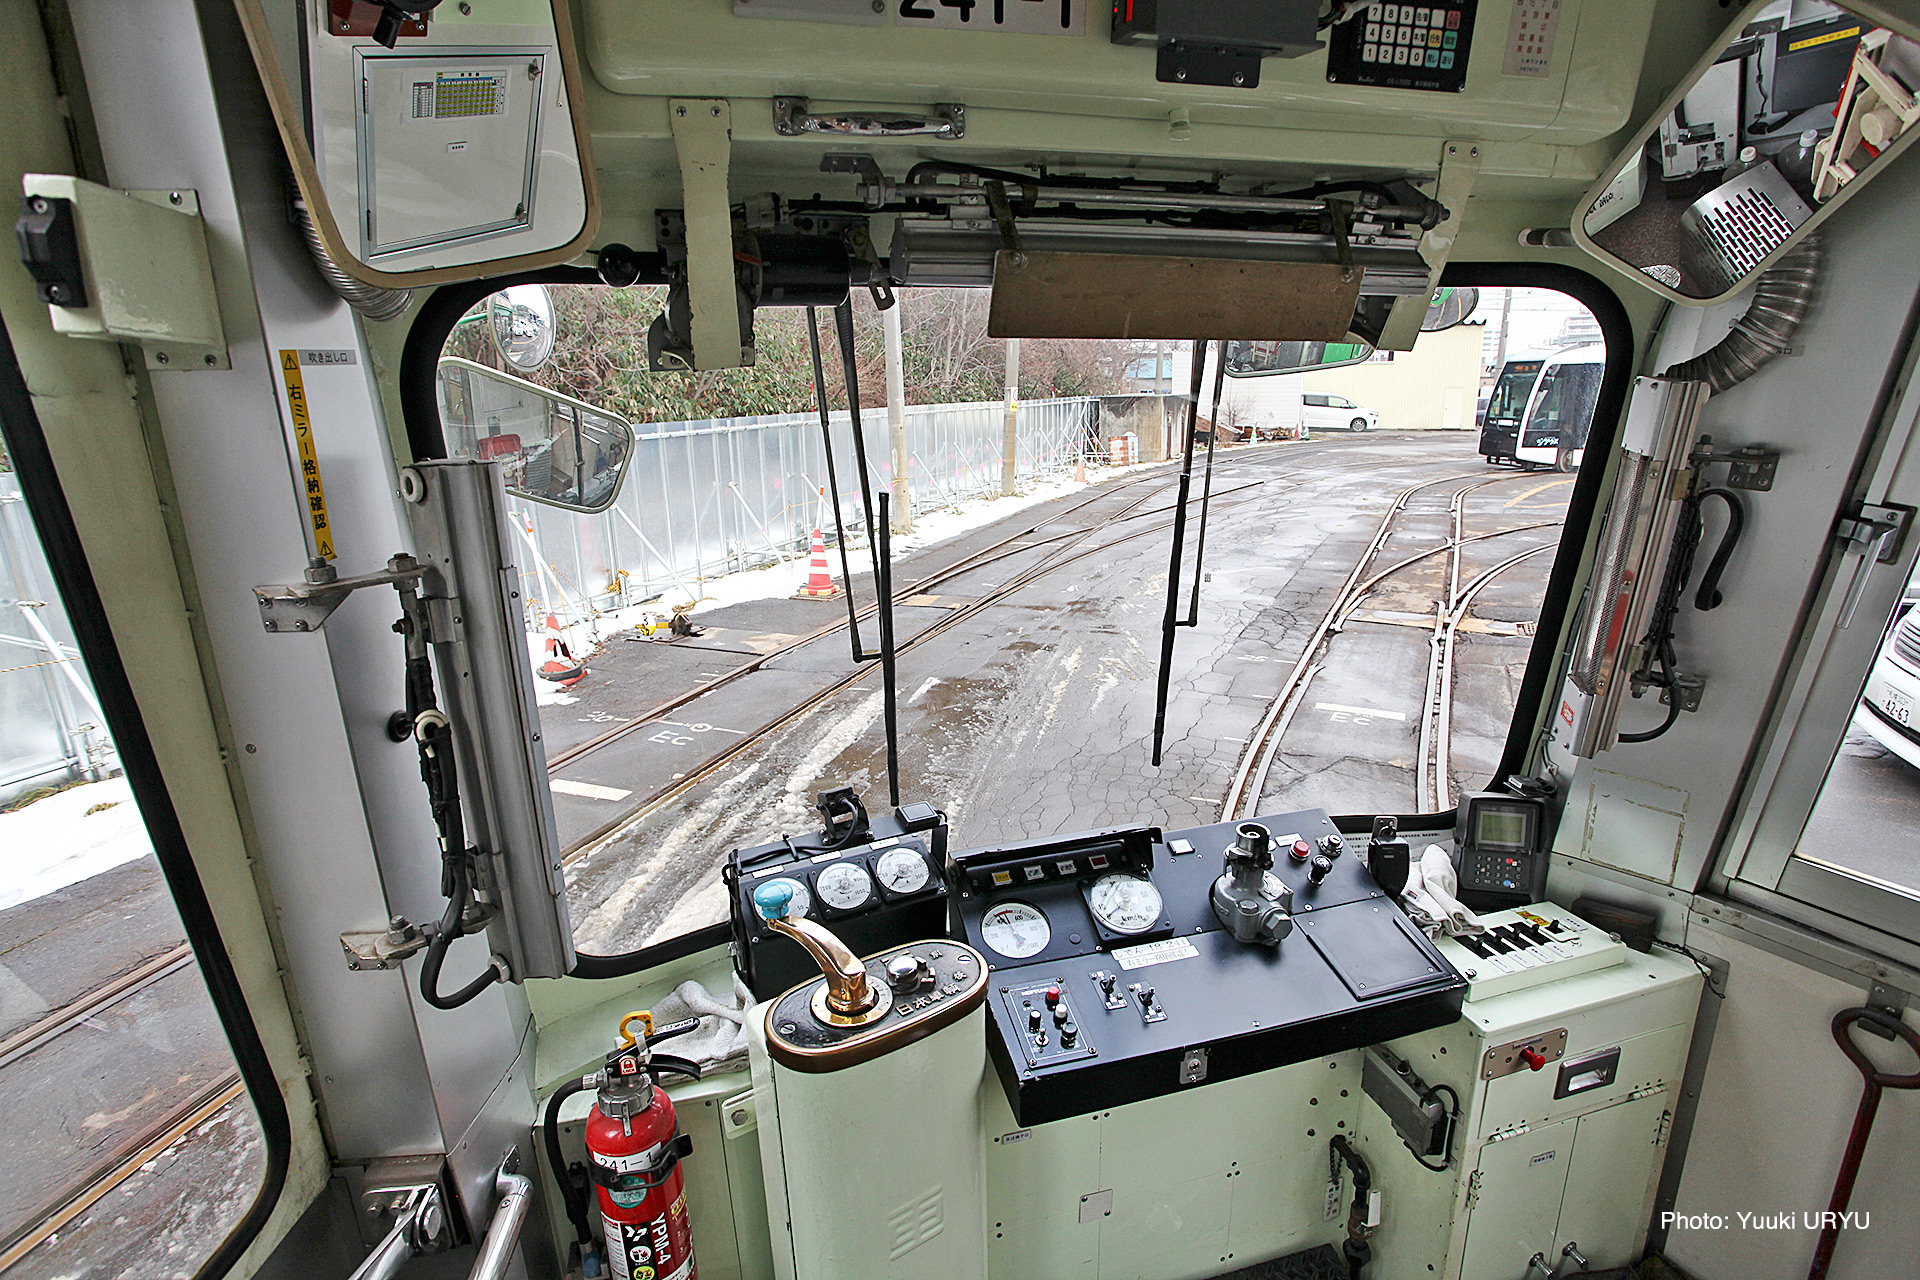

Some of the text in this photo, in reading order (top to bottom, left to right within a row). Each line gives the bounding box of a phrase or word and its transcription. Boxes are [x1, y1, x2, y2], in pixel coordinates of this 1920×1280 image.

[1372, 7, 1378, 16] 7
[1388, 9, 1394, 18] 8
[1404, 10, 1410, 19] 9
[1369, 29, 1375, 38] 4
[1386, 29, 1391, 38] 5
[1401, 31, 1407, 40] 6
[1368, 48, 1372, 57] 1
[1383, 49, 1388, 59] 2
[1399, 51, 1404, 60] 3
[1414, 52, 1420, 62] 0
[308, 352, 348, 363] 吹き出し口
[289, 384, 327, 530] 右ミラー格納確認
[1330, 711, 1371, 726] EC
[648, 730, 694, 745] EC
[1121, 913, 1143, 922] km/h
[1149, 943, 1163, 952] 18
[600, 1152, 654, 1173] 241-1
[650, 1212, 673, 1265] YPM-4
